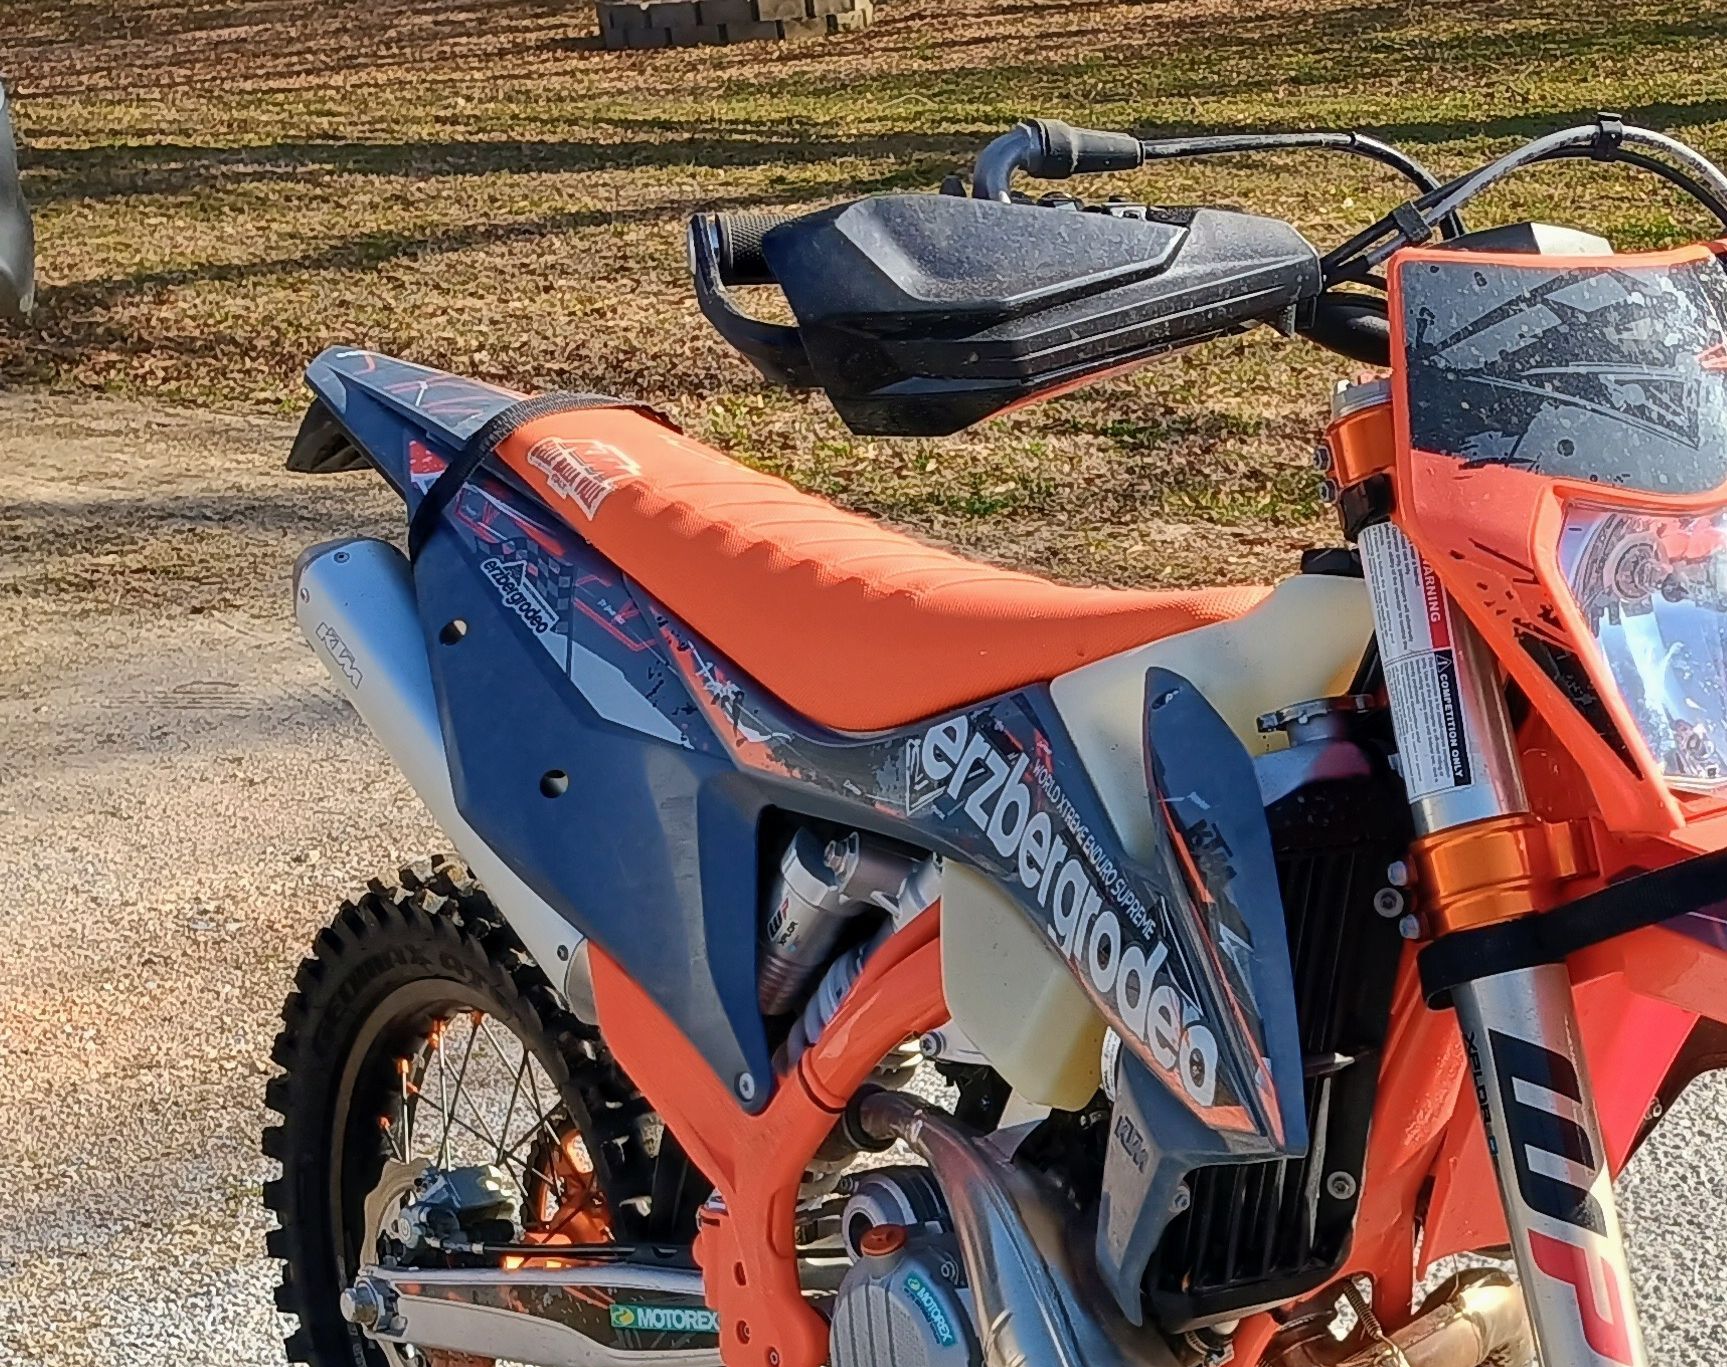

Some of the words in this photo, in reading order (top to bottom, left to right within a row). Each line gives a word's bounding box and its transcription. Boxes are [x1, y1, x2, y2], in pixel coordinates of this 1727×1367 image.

[484, 560, 549, 633] erzbergrodeo
[1422, 560, 1441, 622] ARNING
[315, 622, 363, 690] KTM
[1439, 673, 1458, 747] COMPETITION
[1451, 749, 1464, 778] ONLY
[1033, 759, 1060, 803] WORLD
[1057, 794, 1089, 845] XTREME
[1083, 834, 1118, 886] ENDURO
[1110, 878, 1156, 940] SUPREME
[768, 897, 789, 939] WP
[921, 714, 1219, 1107] erzbergrodeo
[1488, 1028, 1635, 1367] WP
[637, 1307, 720, 1330] MOTOREX
[917, 1287, 952, 1342] MOTOREX
